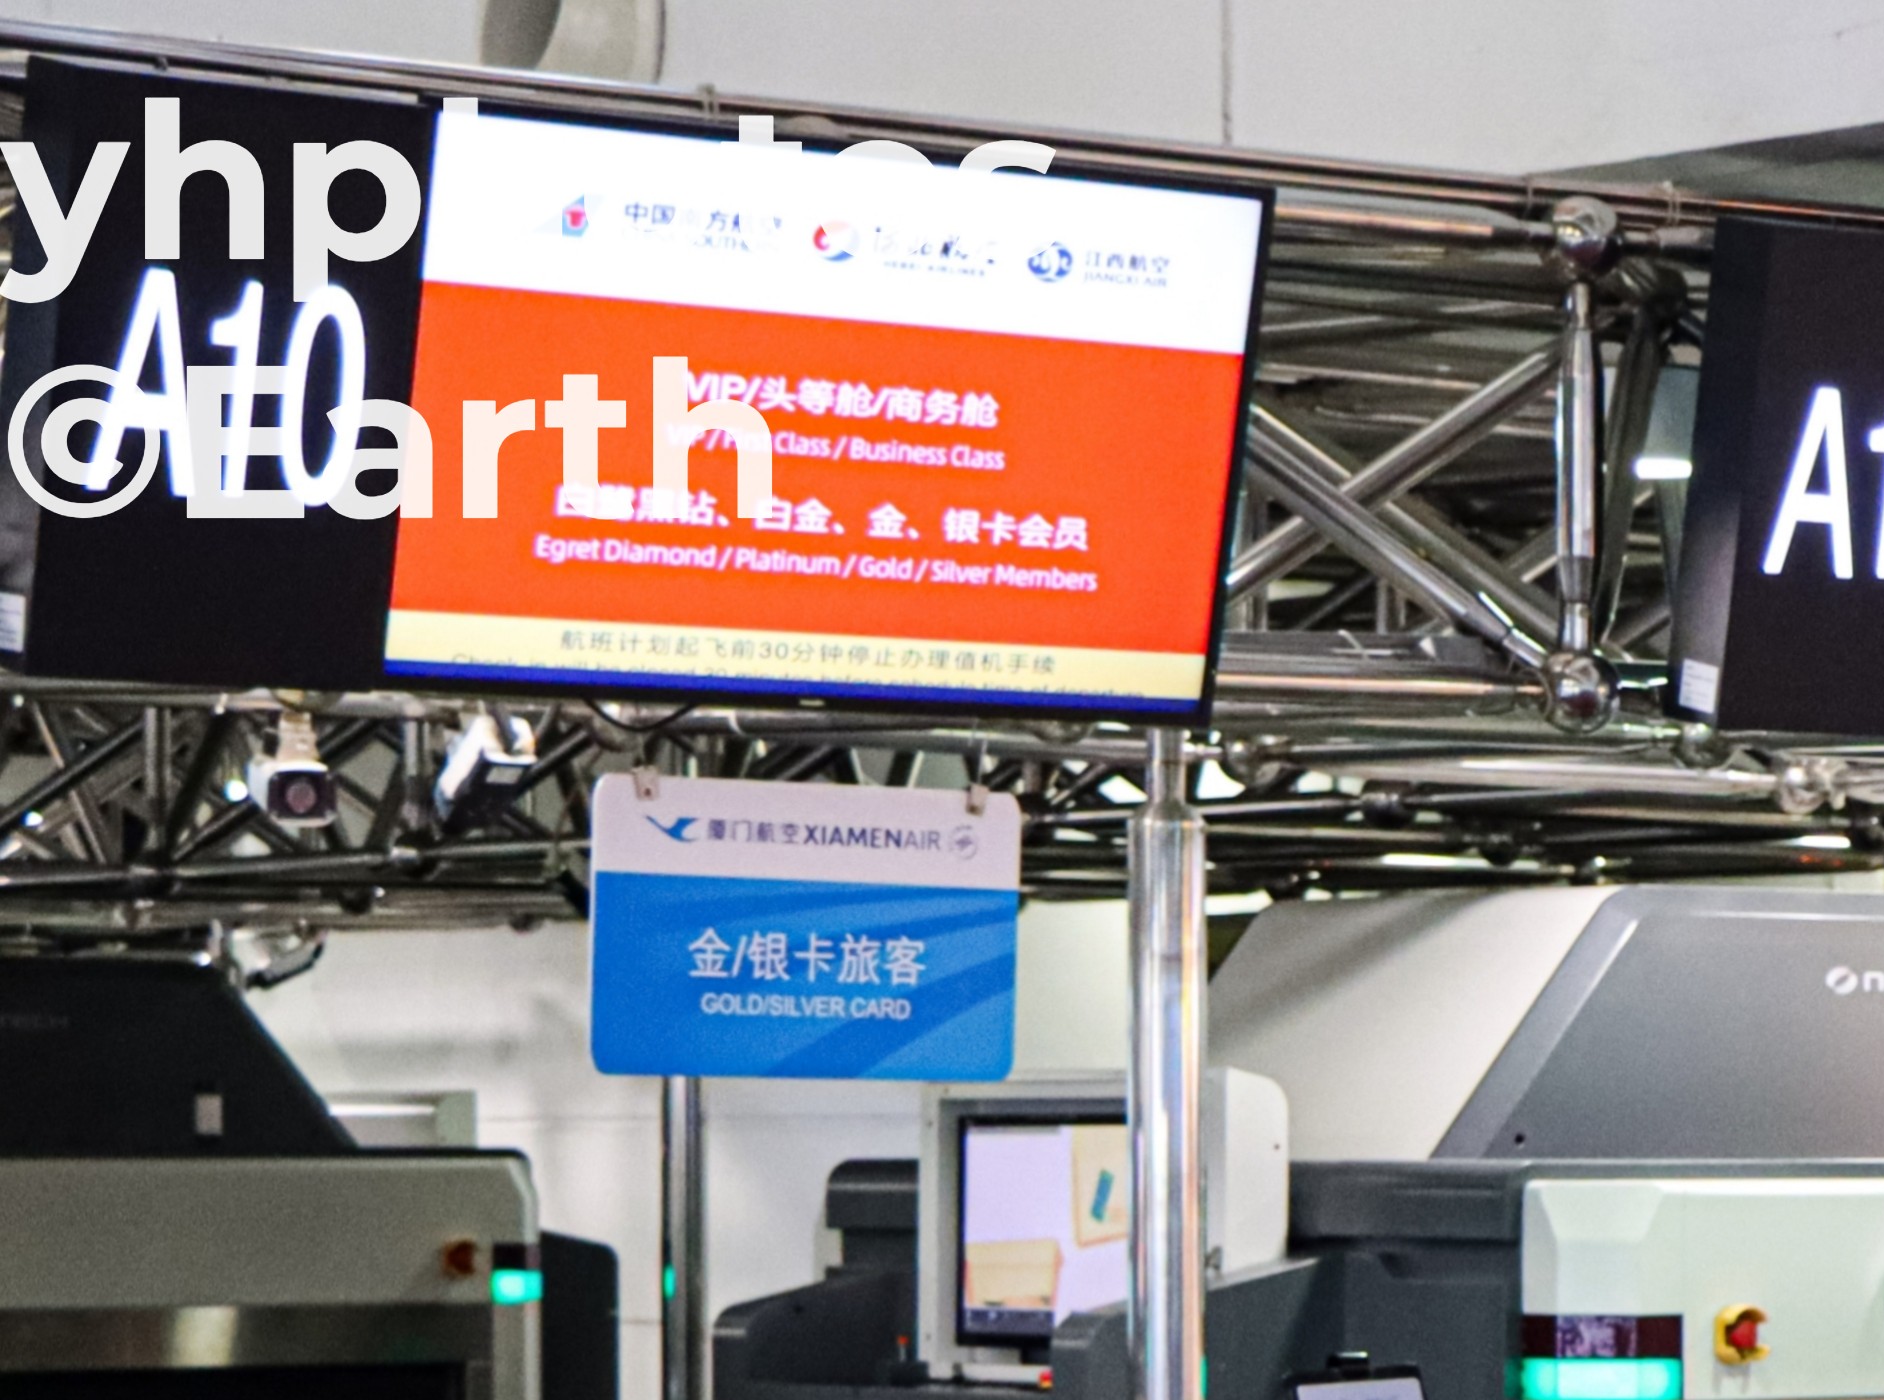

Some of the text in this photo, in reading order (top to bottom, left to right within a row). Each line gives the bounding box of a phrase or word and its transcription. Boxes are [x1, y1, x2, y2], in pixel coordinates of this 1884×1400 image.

[86, 268, 366, 506] A10
[850, 436, 948, 467] Business
[950, 445, 1005, 470] Class
[535, 534, 601, 564] Egret
[603, 538, 717, 569] Diamond
[734, 547, 841, 576] Platinum
[858, 555, 914, 580] Gold
[930, 560, 993, 585] Silver
[994, 564, 1099, 592] Members
[706, 819, 800, 845] 厦门航空
[687, 927, 927, 987] 金/银卡旅客
[700, 992, 912, 1021] GOLD/SILVER CARD
